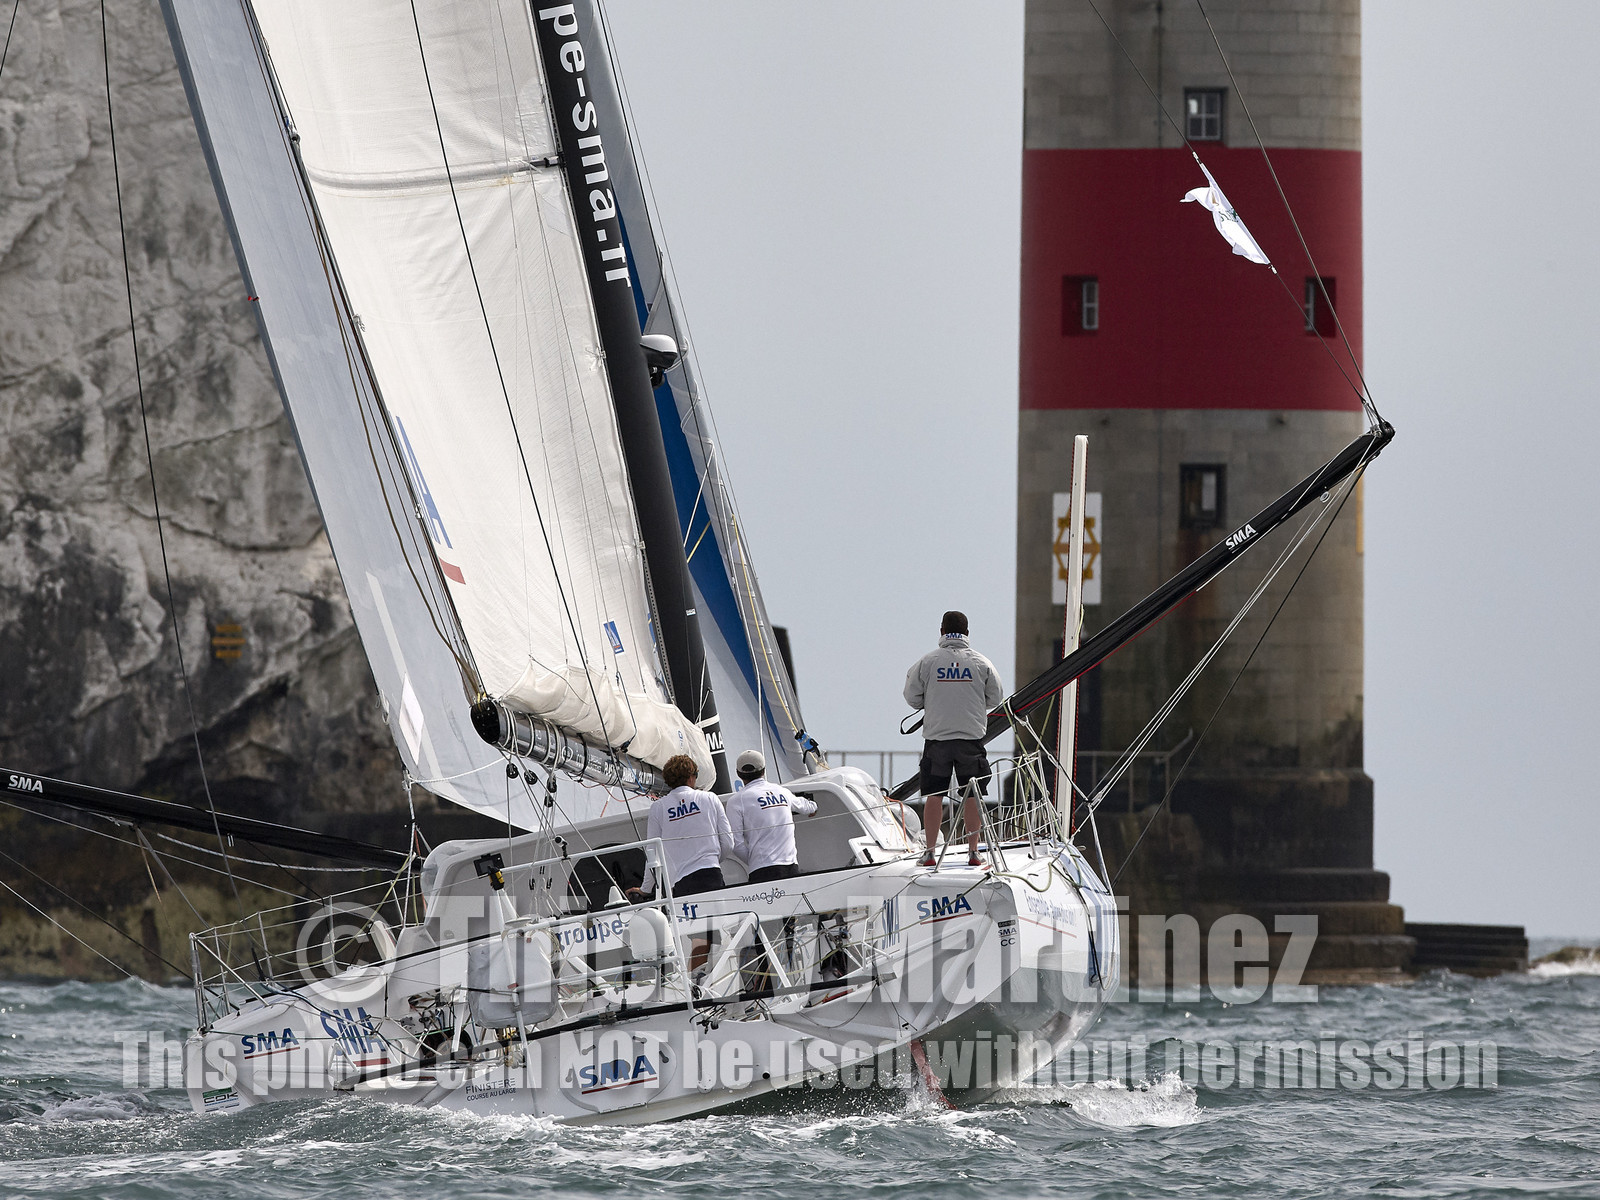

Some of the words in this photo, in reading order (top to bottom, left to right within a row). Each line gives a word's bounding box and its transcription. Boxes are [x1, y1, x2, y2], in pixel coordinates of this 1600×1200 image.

[1225, 523, 1257, 550] SMA
[936, 667, 973, 679] SMA
[8, 774, 44, 793] SMA
[757, 793, 788, 808] SMA
[667, 801, 700, 819] SMA
[916, 893, 972, 920] SMA
[997, 927, 1017, 936] SMA
[1000, 937, 1016, 947] CC
[241, 1027, 300, 1055] SMA
[579, 1055, 657, 1088] SMA
[466, 1092, 489, 1102] COURSE
[498, 1087, 517, 1097] LARGE
